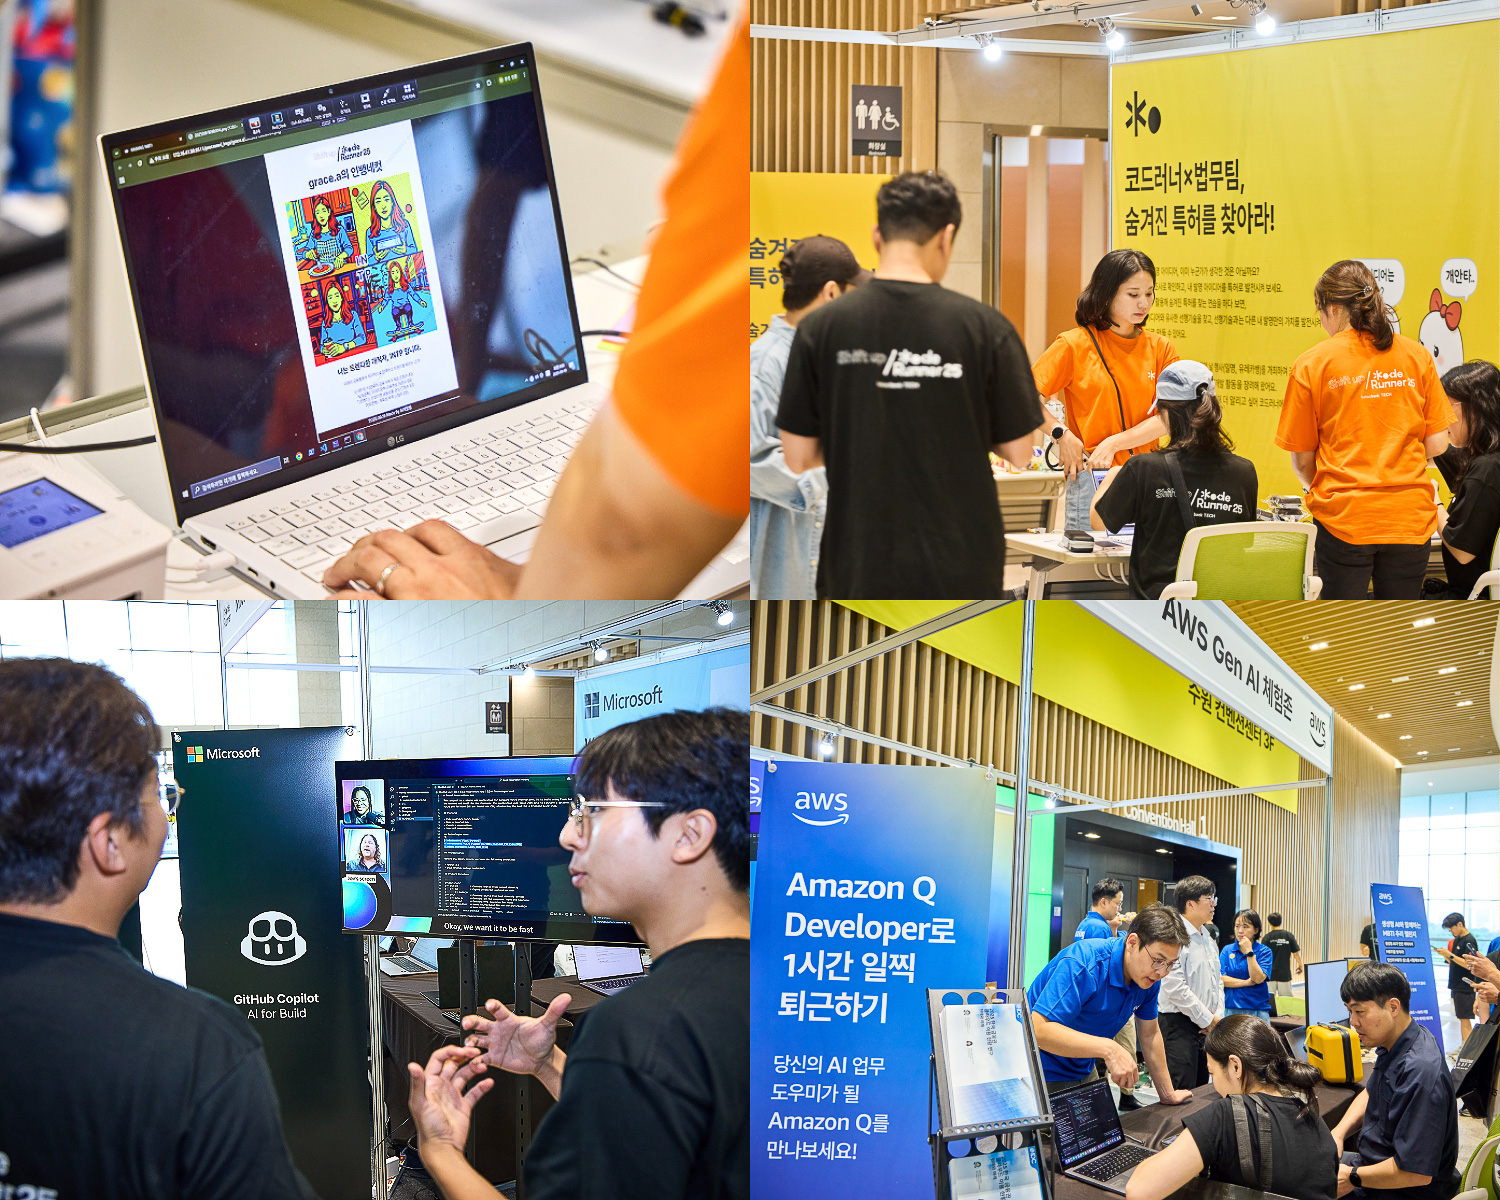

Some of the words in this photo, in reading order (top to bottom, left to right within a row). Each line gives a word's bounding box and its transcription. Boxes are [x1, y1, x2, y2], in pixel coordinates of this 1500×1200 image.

[868, 142, 886, 150] 화장실
[308, 168, 350, 190] grace.a의
[1125, 205, 1168, 236] 숨겨진
[1172, 203, 1217, 236] 특허를
[1221, 201, 1275, 235] 찾아라!
[1224, 267, 1234, 276] 것은
[1236, 267, 1260, 277] 아닐까요?
[1371, 268, 1395, 283] 디어는
[1227, 283, 1243, 292] 특허로
[1265, 284, 1284, 293] 보세요.
[1371, 378, 1406, 390] Runner
[1407, 378, 1416, 388] 25
[395, 434, 405, 444] LG
[1197, 498, 1233, 511] Runner
[1233, 503, 1243, 514] 25
[1162, 600, 1208, 652] AWS
[1213, 635, 1243, 681] Gen
[1246, 663, 1260, 694] AI
[1263, 675, 1293, 722] 체험존
[603, 685, 663, 712] Microsoft
[1309, 711, 1326, 738] aws
[1264, 730, 1275, 752] 3F
[206, 746, 260, 760] Microsoft
[795, 791, 848, 812] aws
[1123, 805, 1180, 832] Convention
[1180, 816, 1197, 836] Hall
[1200, 815, 1209, 840] 1
[786, 872, 904, 899] Amazon
[912, 875, 937, 906] Q
[1378, 892, 1393, 901] aws
[444, 923, 462, 933] Okay,
[475, 924, 492, 932] want
[493, 924, 499, 932] it
[500, 924, 507, 932] to
[508, 924, 517, 933] be
[519, 925, 534, 934] fast
[785, 911, 956, 946] Developer로
[783, 950, 854, 981] 1시간
[861, 951, 916, 983] 일찍
[233, 994, 275, 1005] GitHub
[277, 993, 320, 1006] Copilot
[777, 990, 888, 1024] 퇴근하기
[248, 1009, 259, 1019] AI
[261, 1008, 277, 1019] for
[280, 1008, 307, 1018] Build
[774, 1055, 823, 1075] 당신의
[827, 1056, 847, 1074] AI
[852, 1056, 885, 1076] 업무
[771, 1083, 839, 1104] 도우미가
[843, 1084, 860, 1104] 될
[768, 1112, 849, 1131] Amazon
[856, 1114, 890, 1135] Q를
[767, 1140, 858, 1161] 만나보세요!
[1001, 1156, 1009, 1169] 2025
